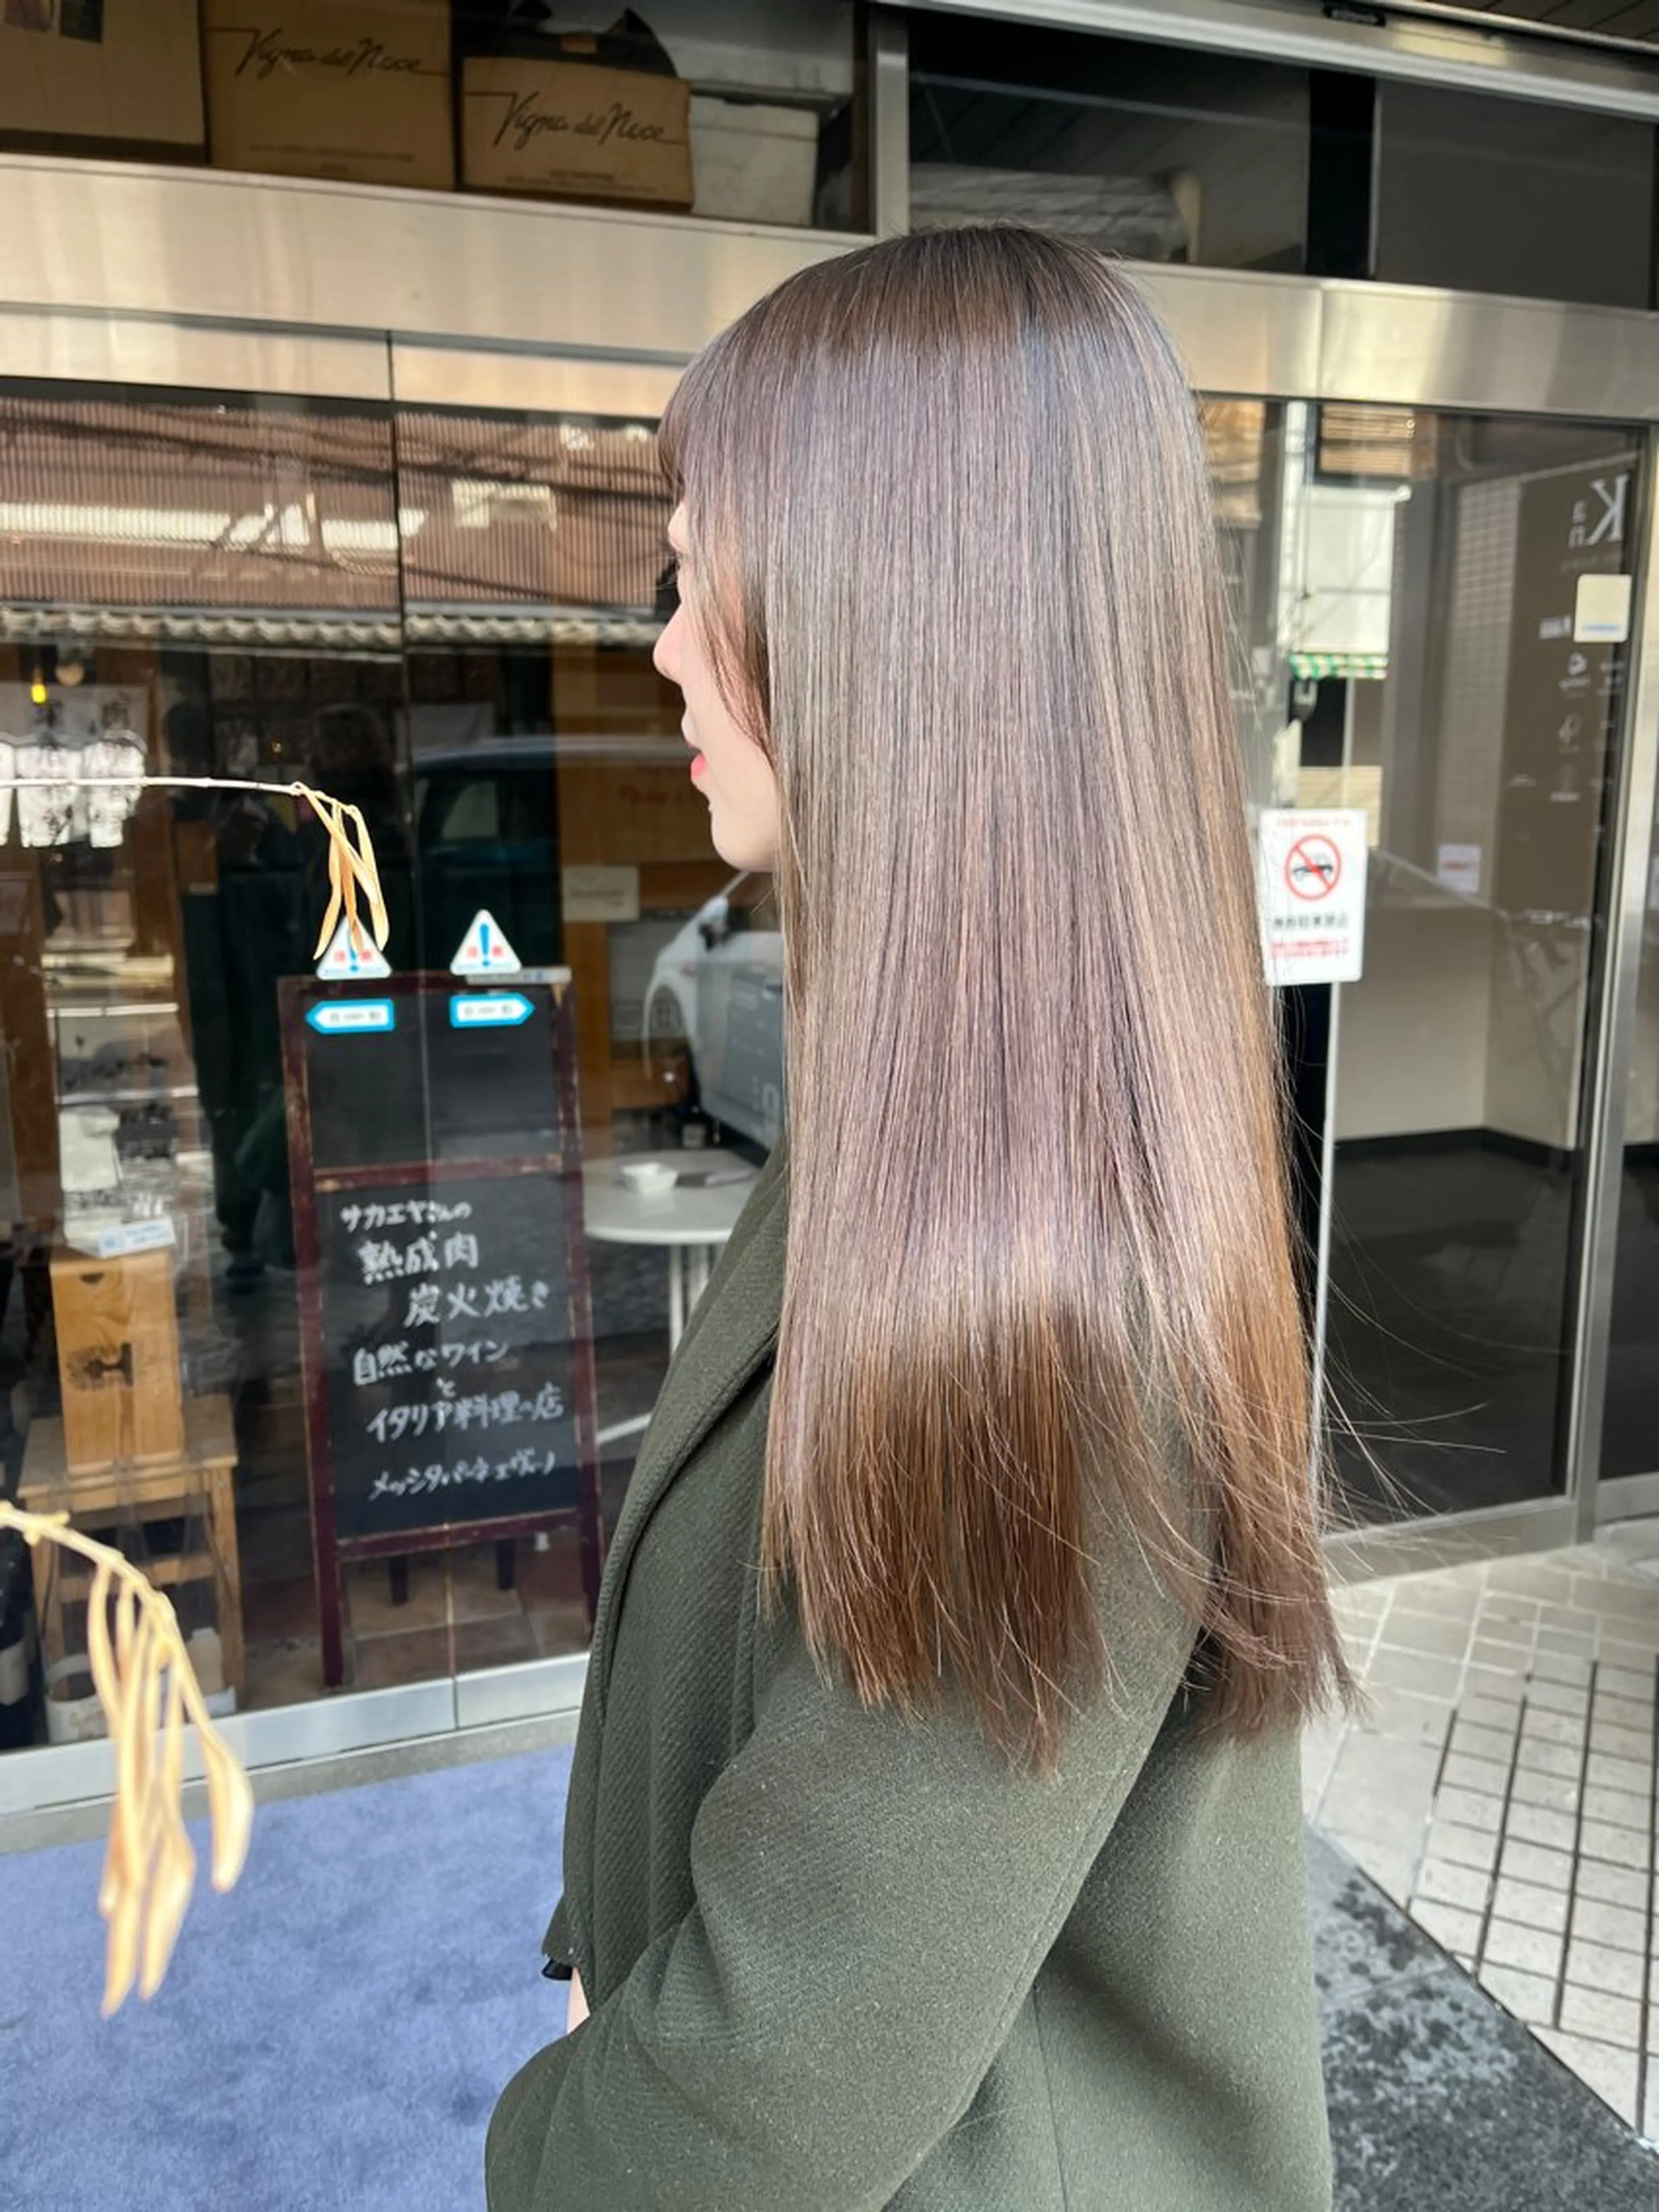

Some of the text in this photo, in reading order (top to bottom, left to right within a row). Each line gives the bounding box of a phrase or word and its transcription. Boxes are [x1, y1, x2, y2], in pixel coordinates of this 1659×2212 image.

[358, 1230, 479, 1286] 熟成肉
[403, 1274, 550, 1329] 炭火焼き
[353, 1340, 509, 1386] 自然なワイン
[435, 1376, 457, 1398] と
[366, 1381, 564, 1444] イタリア料理の店
